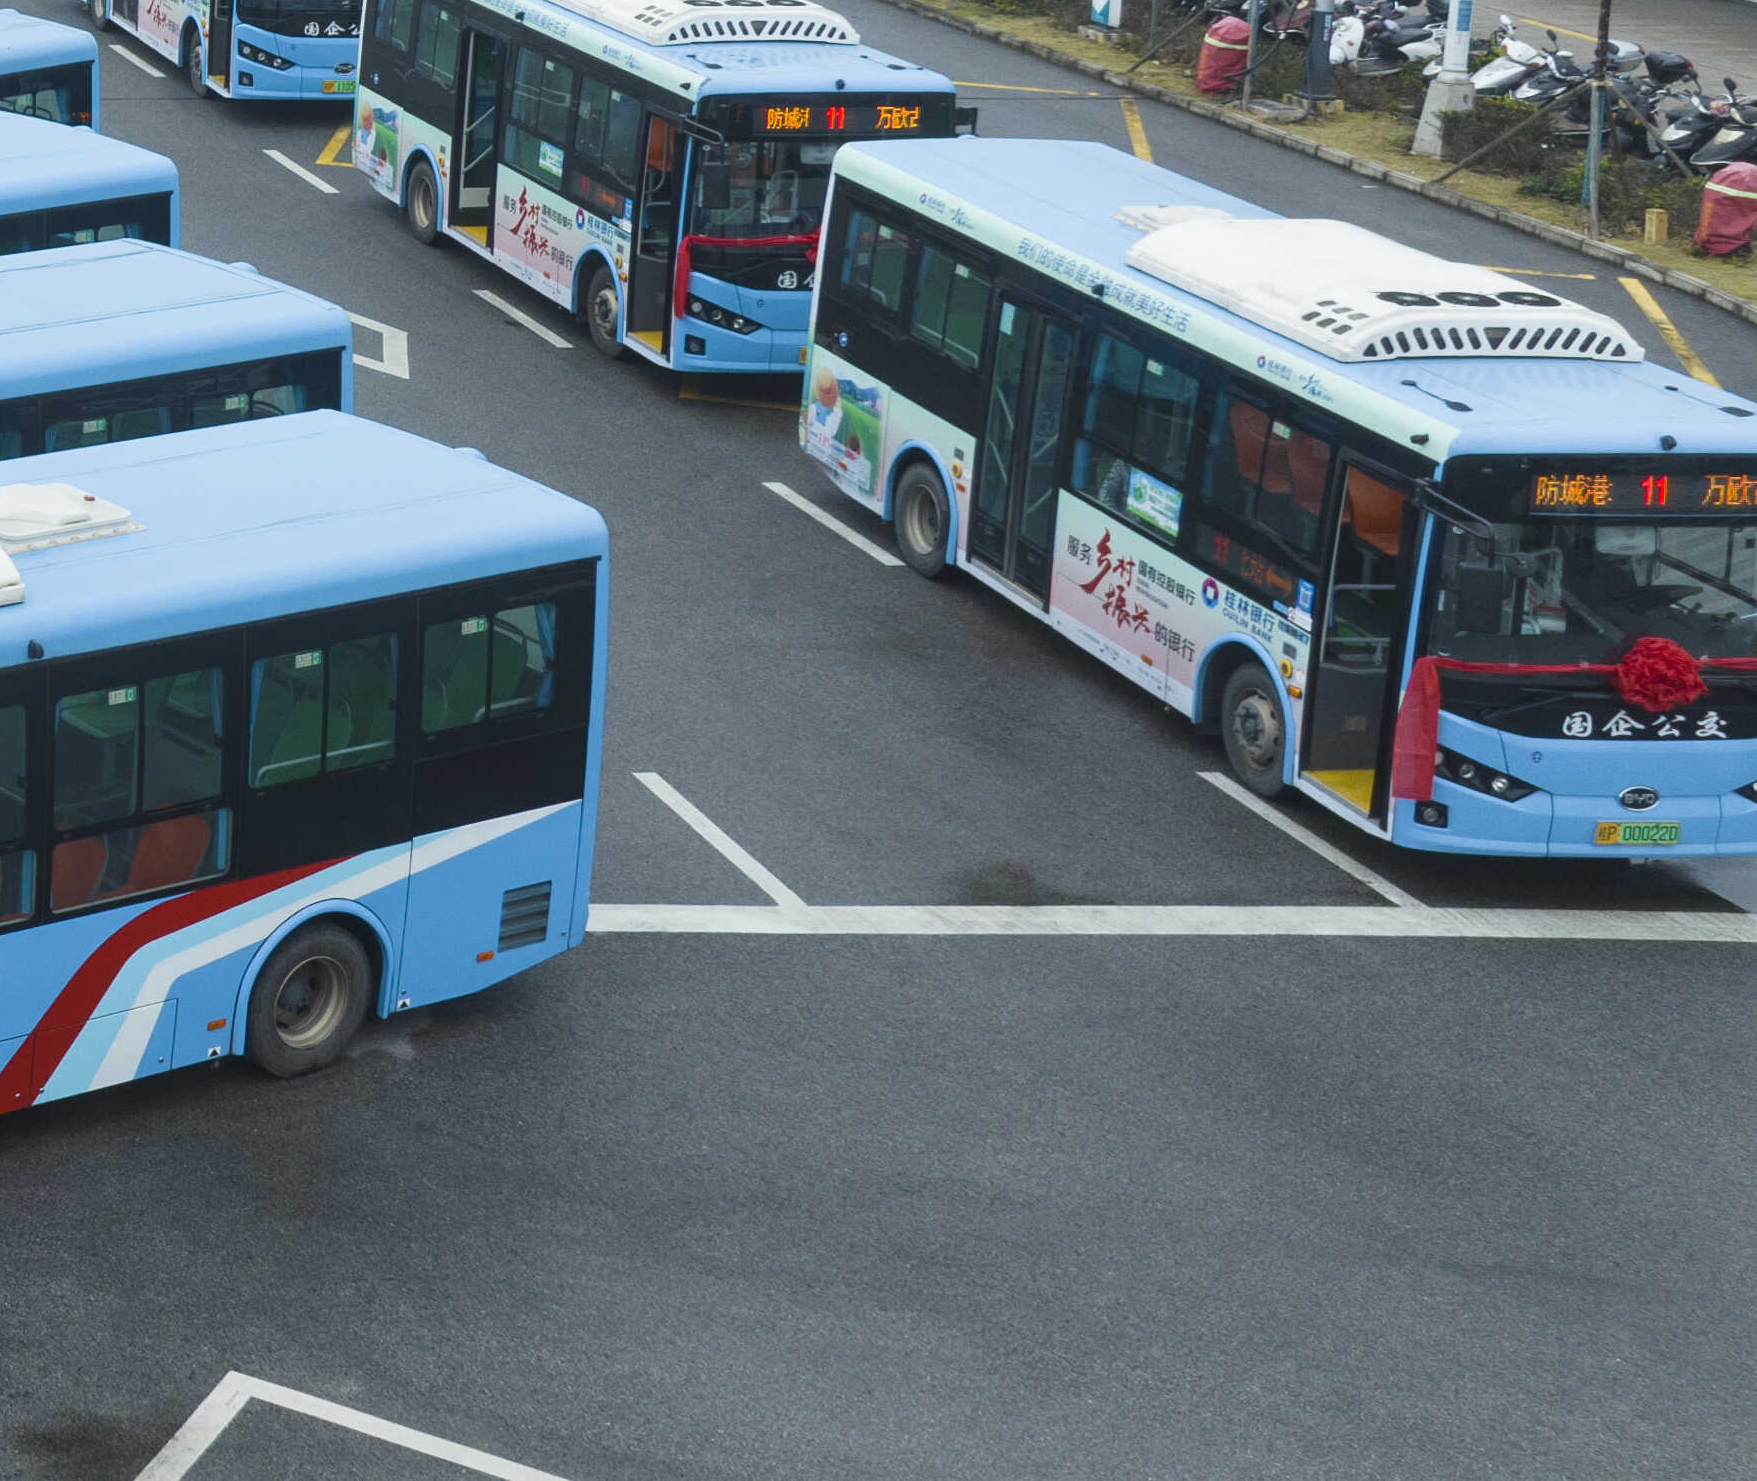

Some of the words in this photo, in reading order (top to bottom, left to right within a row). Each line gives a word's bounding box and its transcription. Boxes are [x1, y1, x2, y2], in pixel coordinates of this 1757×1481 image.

[825, 106, 846, 130] 11
[1640, 474, 1669, 507] 11
[1066, 534, 1093, 566] 服务
[1080, 527, 1136, 594] 乡村
[1138, 558, 1197, 607] 国有控股银行
[1101, 584, 1152, 635] 振兴
[1224, 589, 1277, 633] 桂林银行
[1154, 621, 1196, 662] 的银行
[1251, 624, 1273, 644] BANK
[1561, 709, 1729, 739] 国企公交
[1623, 792, 1655, 804] BYD
